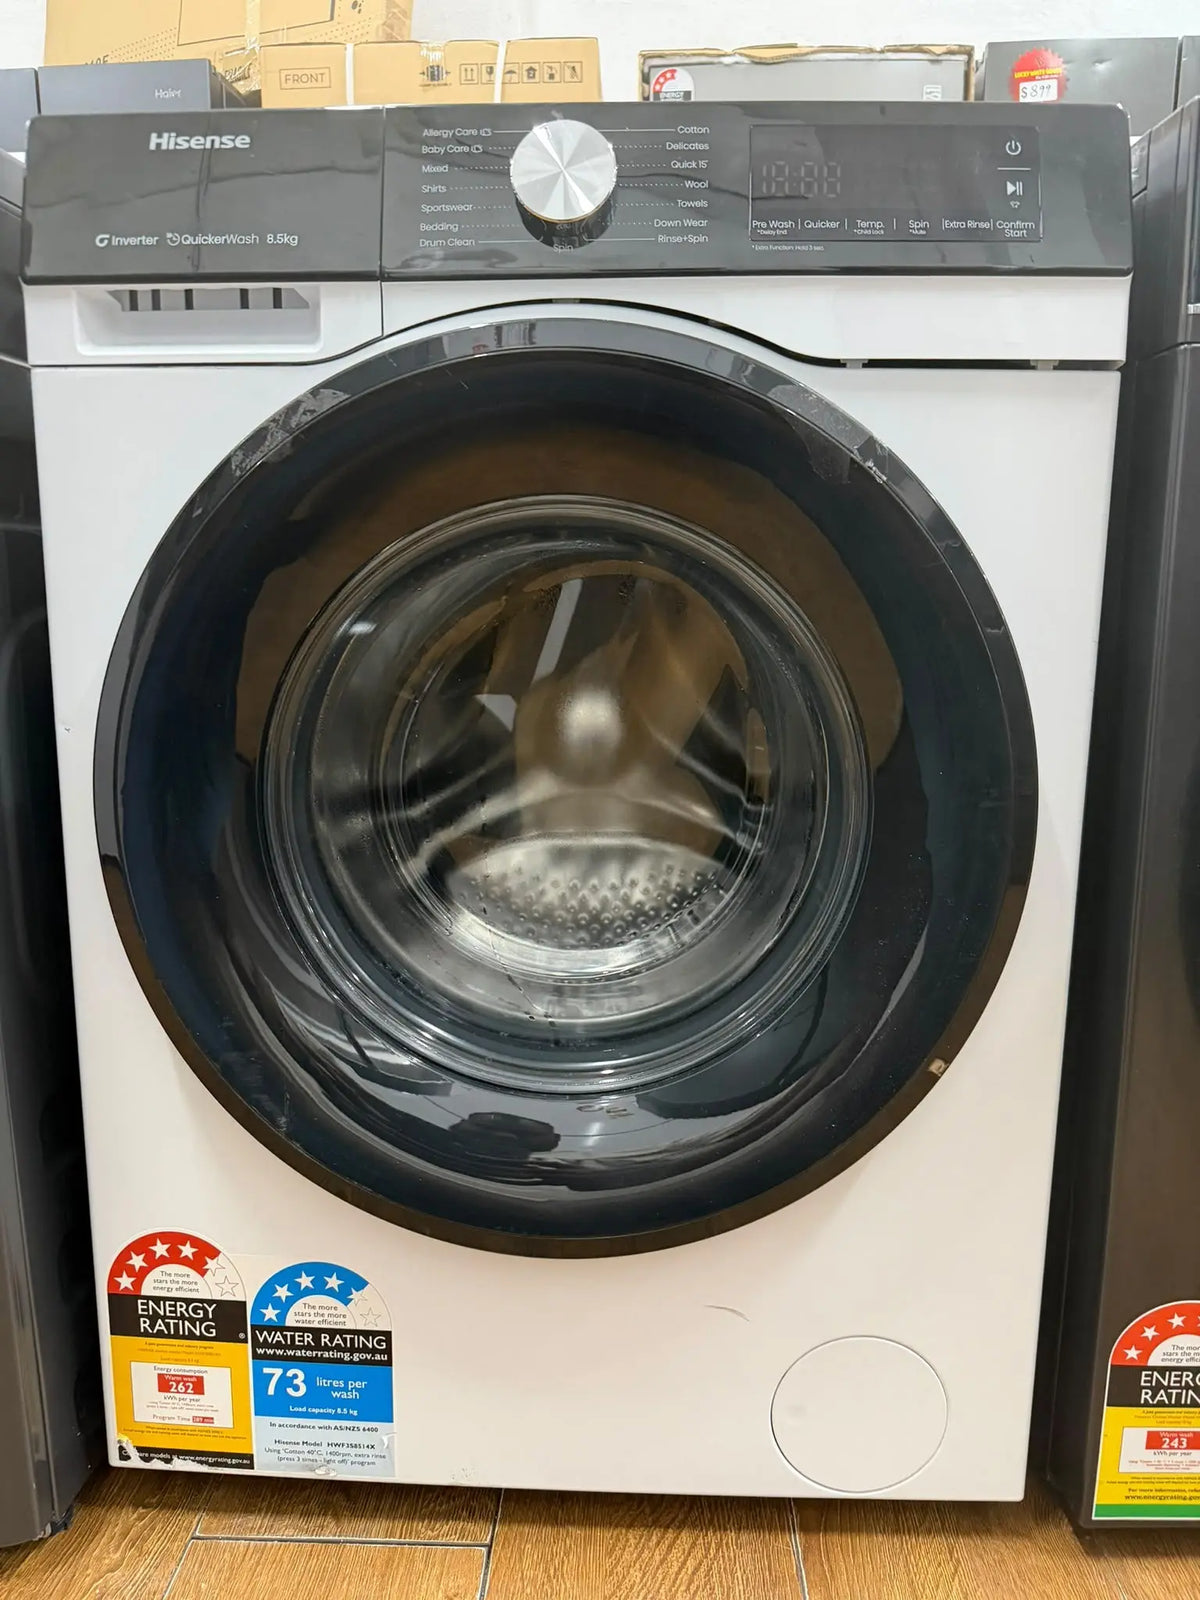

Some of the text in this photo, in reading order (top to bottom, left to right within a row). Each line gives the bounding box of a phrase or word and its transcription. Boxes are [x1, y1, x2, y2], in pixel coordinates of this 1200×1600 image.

[284, 72, 326, 85] FRONT
[154, 88, 182, 99] Haier
[423, 127, 478, 138] Allergy Care
[677, 125, 710, 134] Cotton
[149, 132, 251, 150] Hisense
[666, 141, 710, 150] Delicates
[422, 144, 470, 155] Baby Care
[422, 164, 449, 173] Mixed
[671, 160, 698, 169] Quick
[421, 184, 447, 193] Shirts
[684, 179, 709, 189] Wool
[421, 203, 473, 214] Sportswear
[677, 199, 709, 208] Towels
[420, 222, 459, 232] Bedding
[654, 218, 708, 227] Down Wear
[752, 219, 795, 229] Pre Wash
[804, 219, 840, 229] Quicker
[856, 219, 885, 230] Temp.
[908, 219, 930, 230] Spin
[944, 219, 990, 229] Extra Rinse
[996, 220, 1035, 230] Confirm
[1004, 228, 1027, 238] Start
[111, 233, 299, 247] Inverter QuickerWash 8.5kg
[419, 237, 475, 247] Drum Clean
[658, 234, 709, 244] Rinse+Spin
[552, 243, 575, 253] Spin
[160, 1270, 191, 1279] The more
[169, 1278, 180, 1286] the
[152, 1286, 200, 1294] energy efficient
[137, 1299, 217, 1319] ENERGY
[302, 1302, 339, 1312] The more
[313, 1311, 326, 1319] the
[140, 1317, 217, 1338] RATING
[294, 1318, 347, 1327] water efficient
[255, 1329, 388, 1350] WATER RATING
[255, 1345, 388, 1362] www.waterrating.gov.au
[153, 1365, 172, 1373] Energy
[168, 1381, 195, 1394] 262
[262, 1367, 307, 1398] 73
[316, 1376, 368, 1390] litres per
[330, 1389, 360, 1400] wash
[289, 1405, 307, 1413] Load
[307, 1407, 335, 1416] capacity
[277, 1422, 316, 1430] accordance
[1161, 1437, 1188, 1449] 243
[264, 1447, 281, 1455] Using
[277, 1455, 296, 1463] (press
[323, 1457, 337, 1465] light
